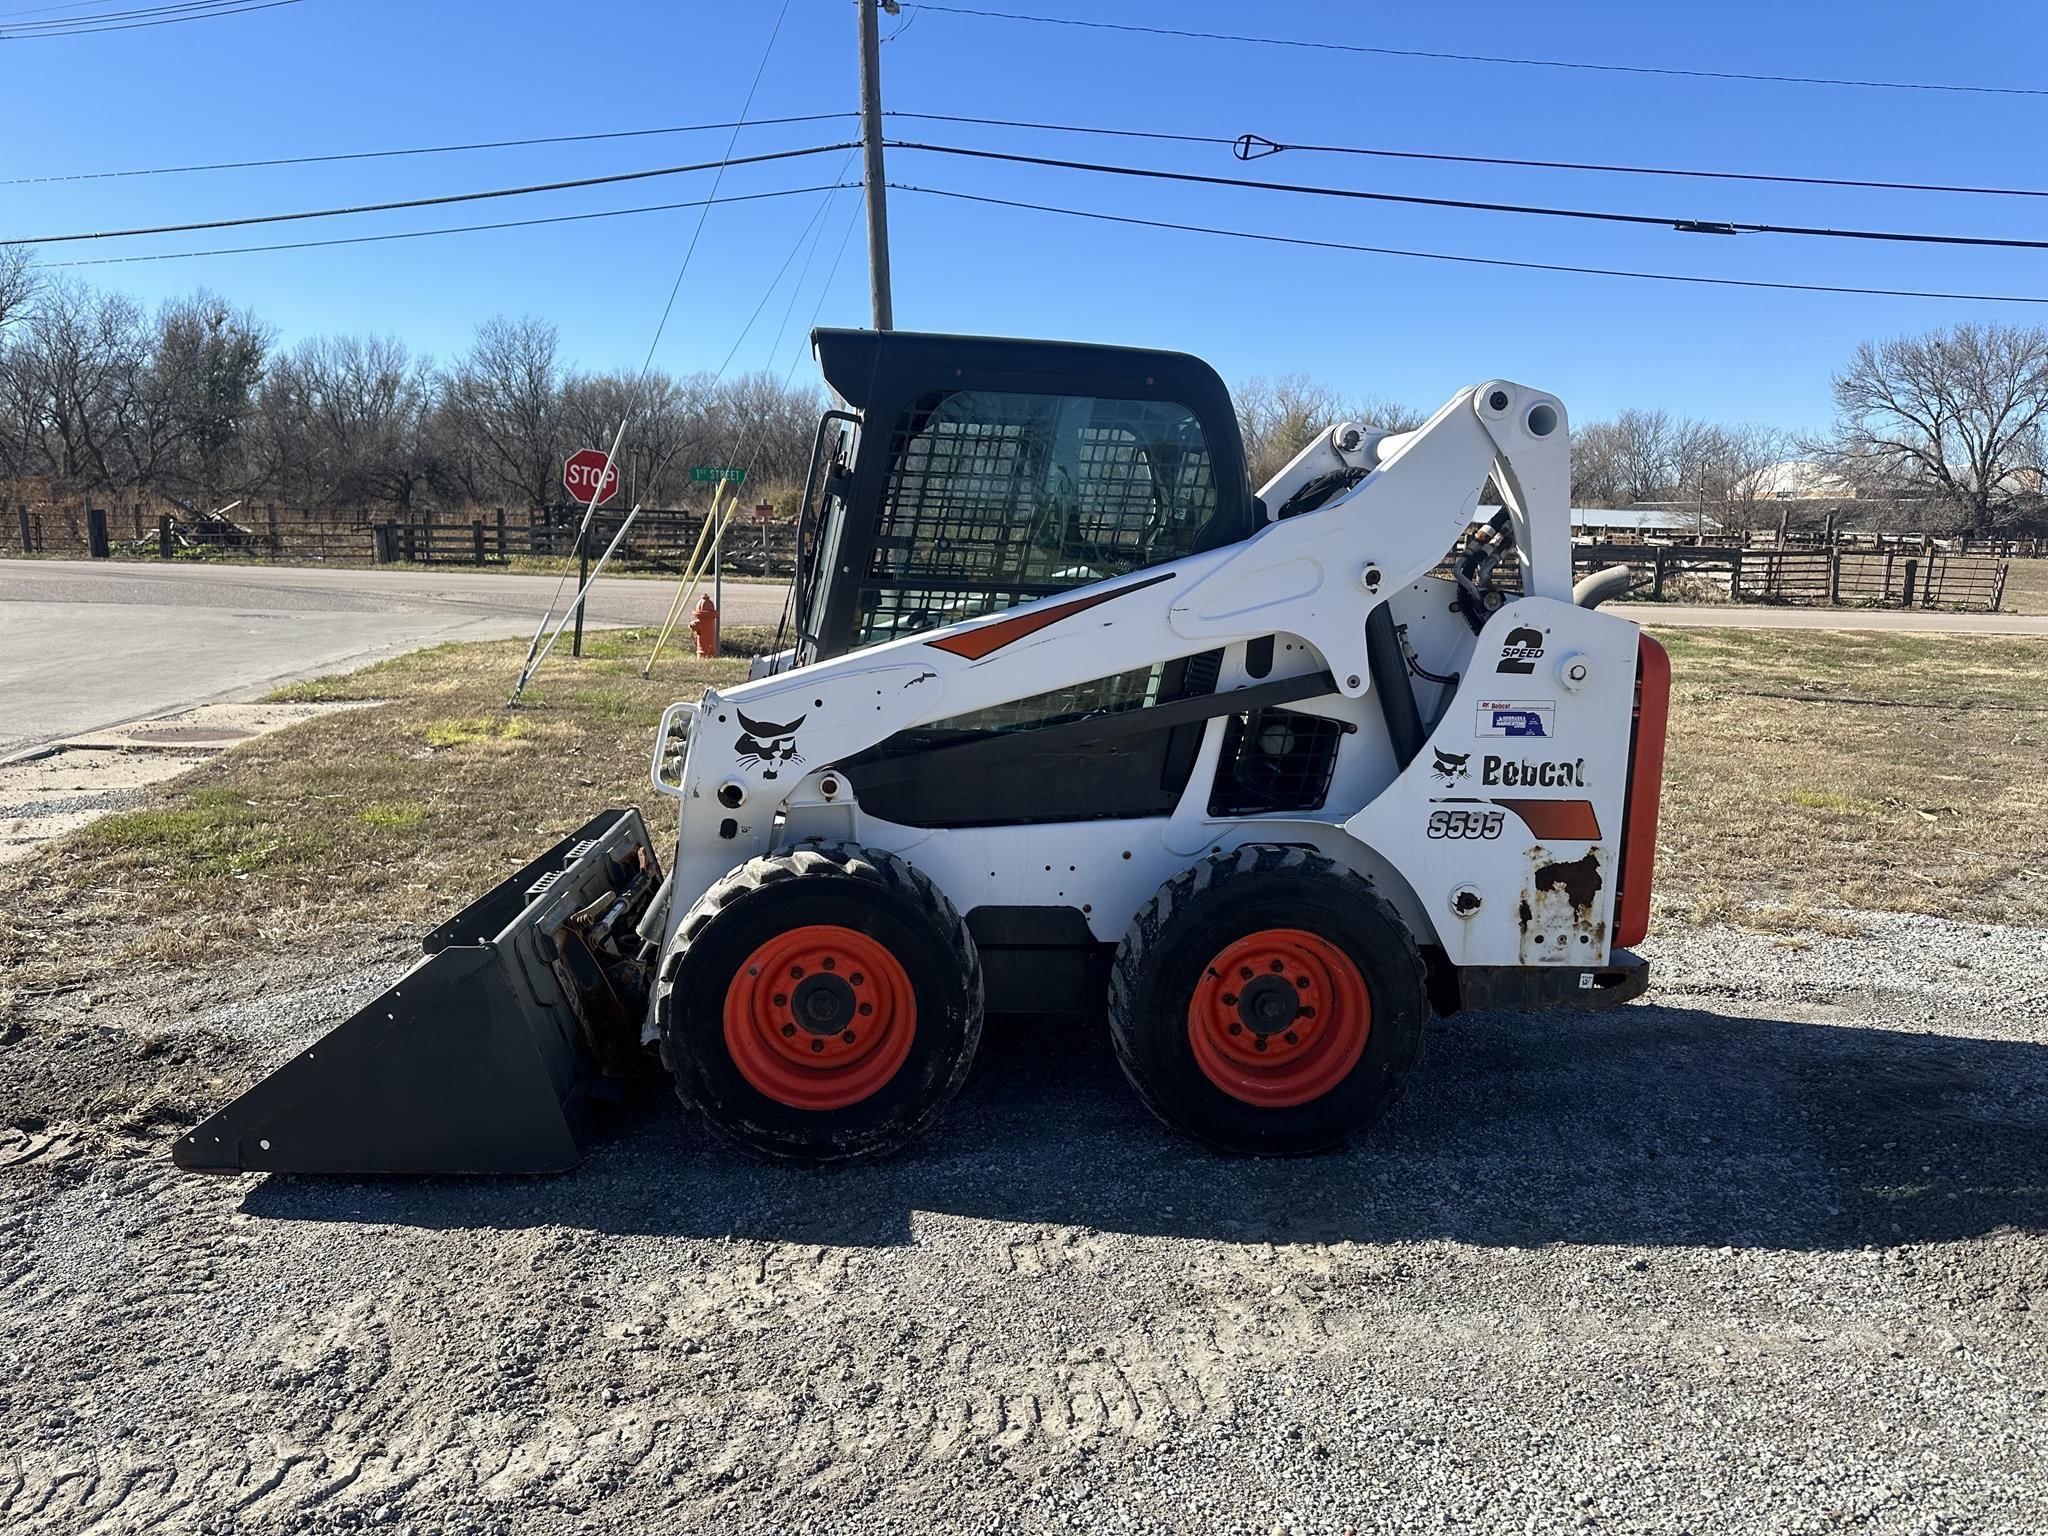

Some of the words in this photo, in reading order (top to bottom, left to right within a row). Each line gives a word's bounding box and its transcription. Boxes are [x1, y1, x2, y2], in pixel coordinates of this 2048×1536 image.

[568, 464, 615, 489] STOP
[710, 469, 740, 480] STREET
[1496, 626, 1543, 674] 2
[1501, 647, 1545, 658] SPEED
[1482, 755, 1585, 787] Bobcat
[1427, 811, 1505, 840] S595
